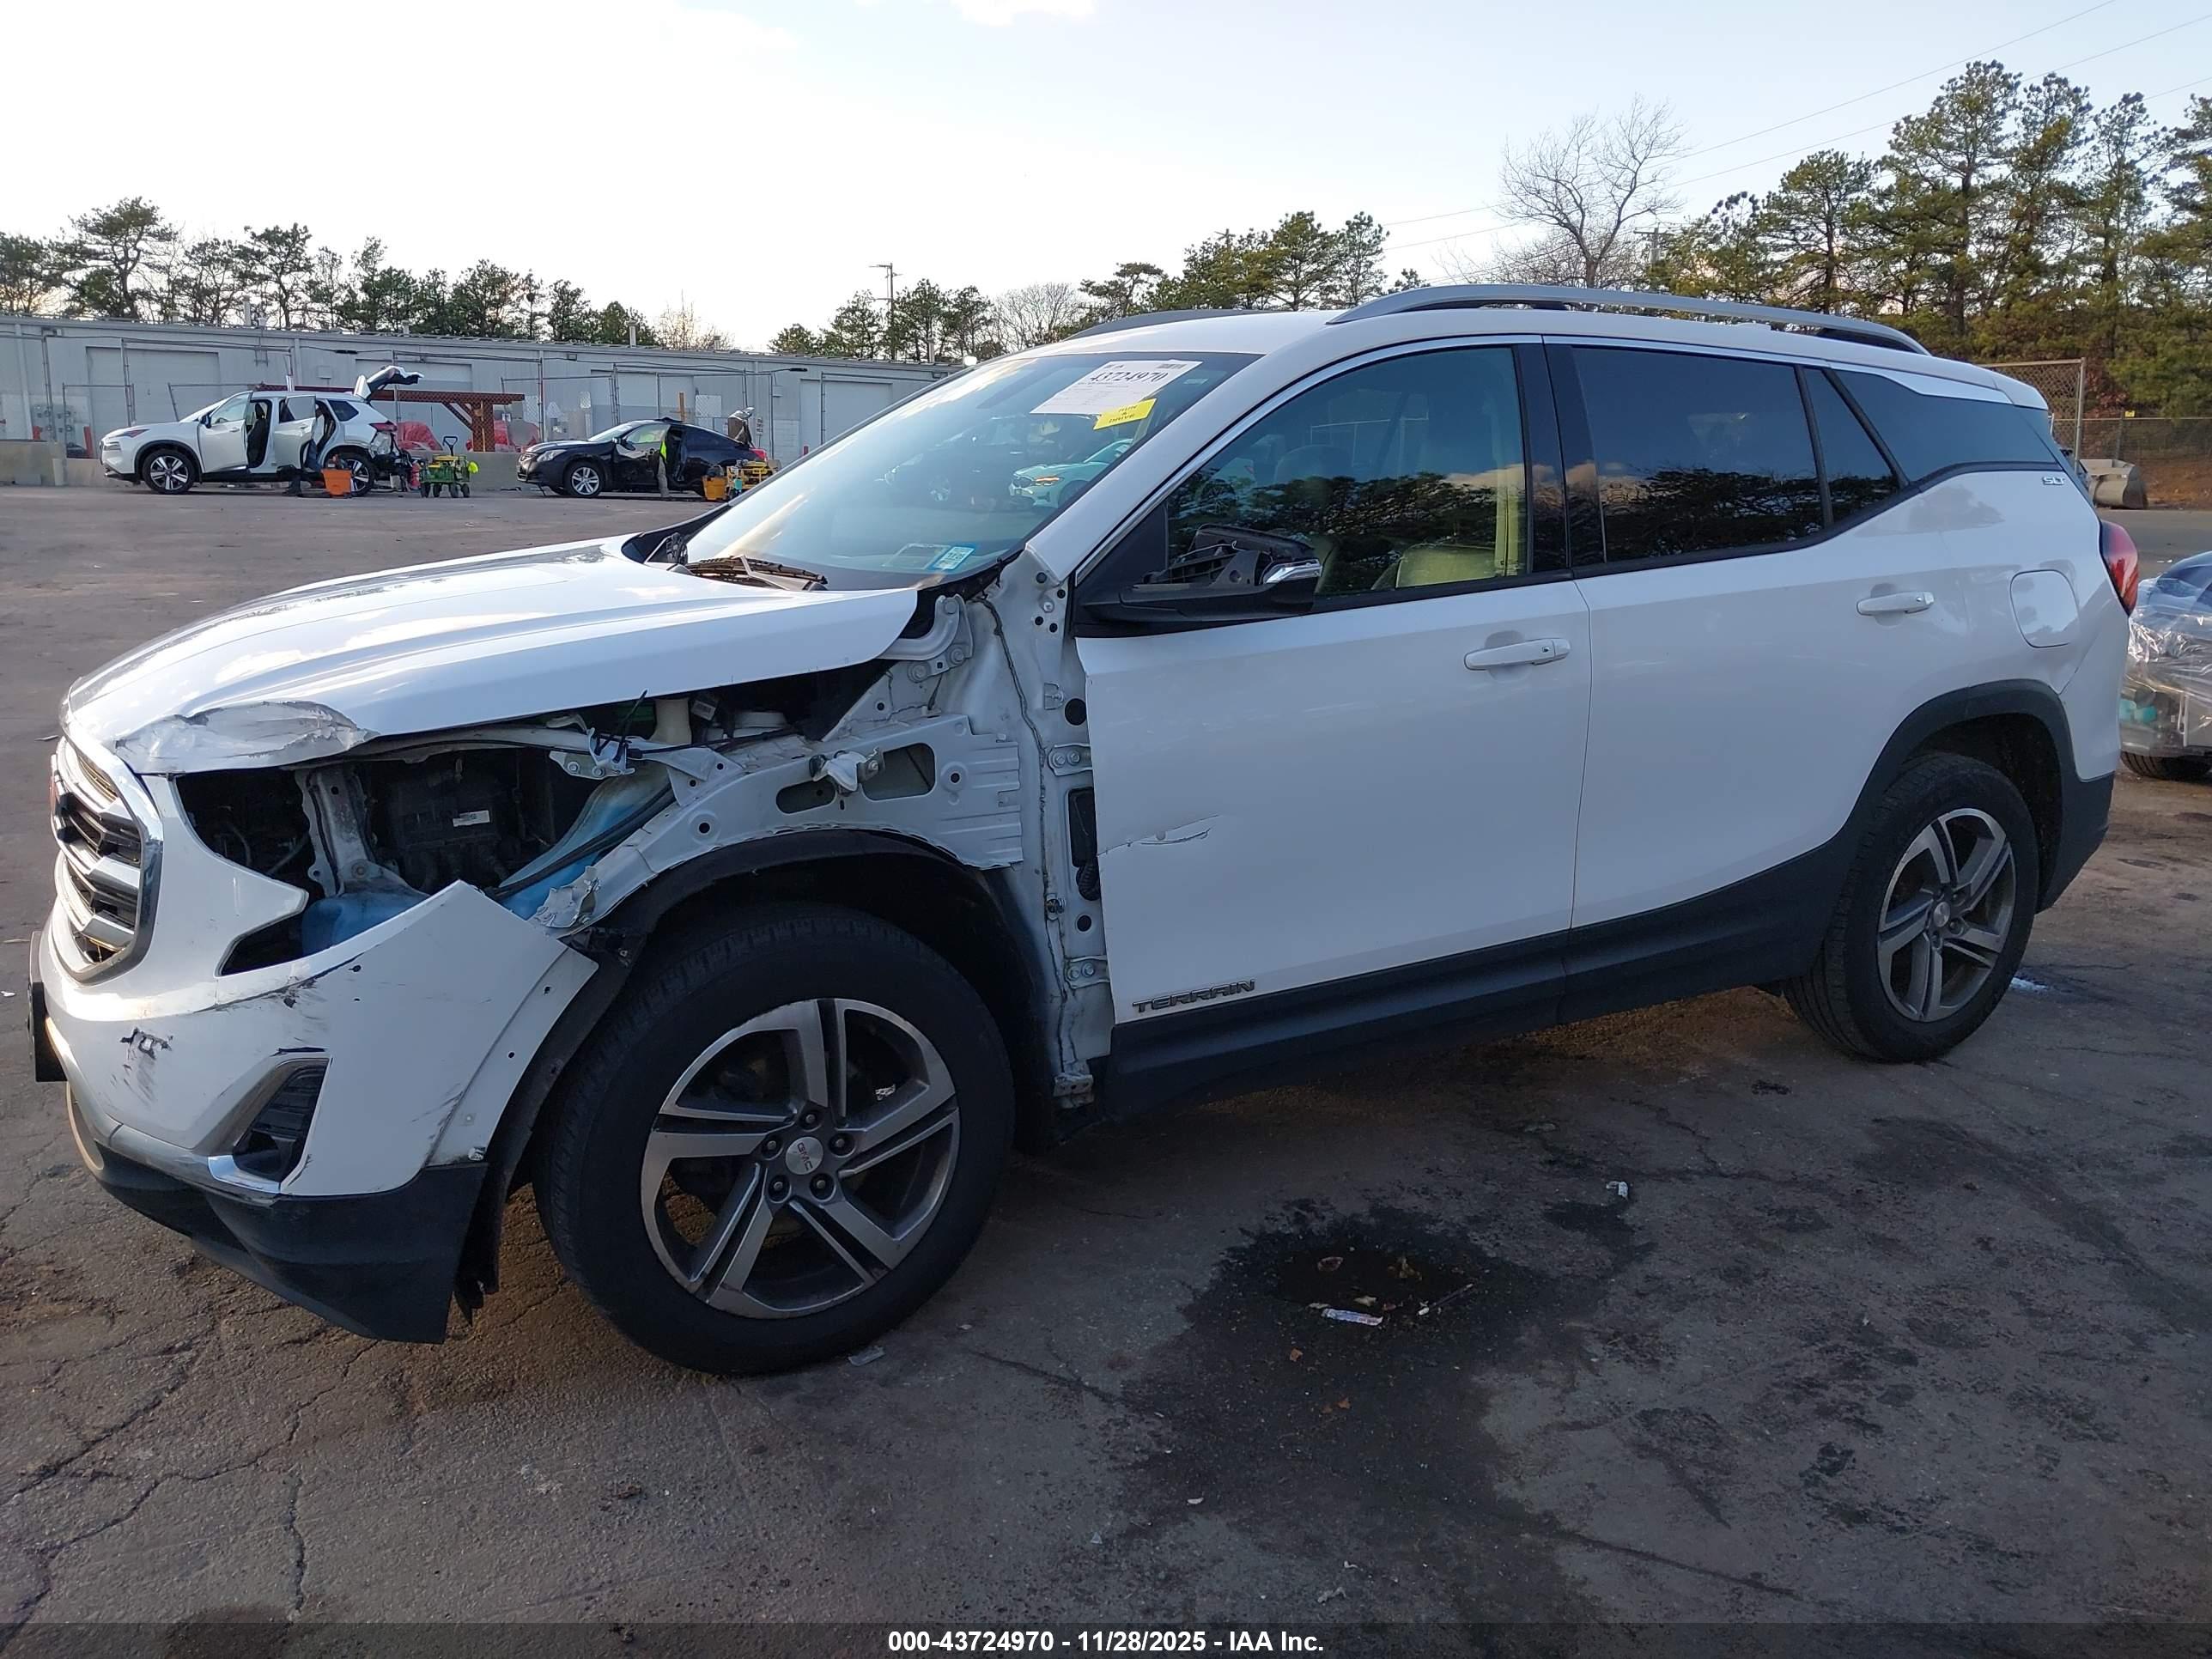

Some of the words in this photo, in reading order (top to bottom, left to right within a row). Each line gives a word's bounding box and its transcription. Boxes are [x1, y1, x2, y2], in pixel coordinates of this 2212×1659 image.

[1091, 371, 1169, 382] 43724970
[2042, 477, 2065, 486] SLT
[1132, 978, 1256, 1013] TERRAIN
[797, 1141, 814, 1171] GMC
